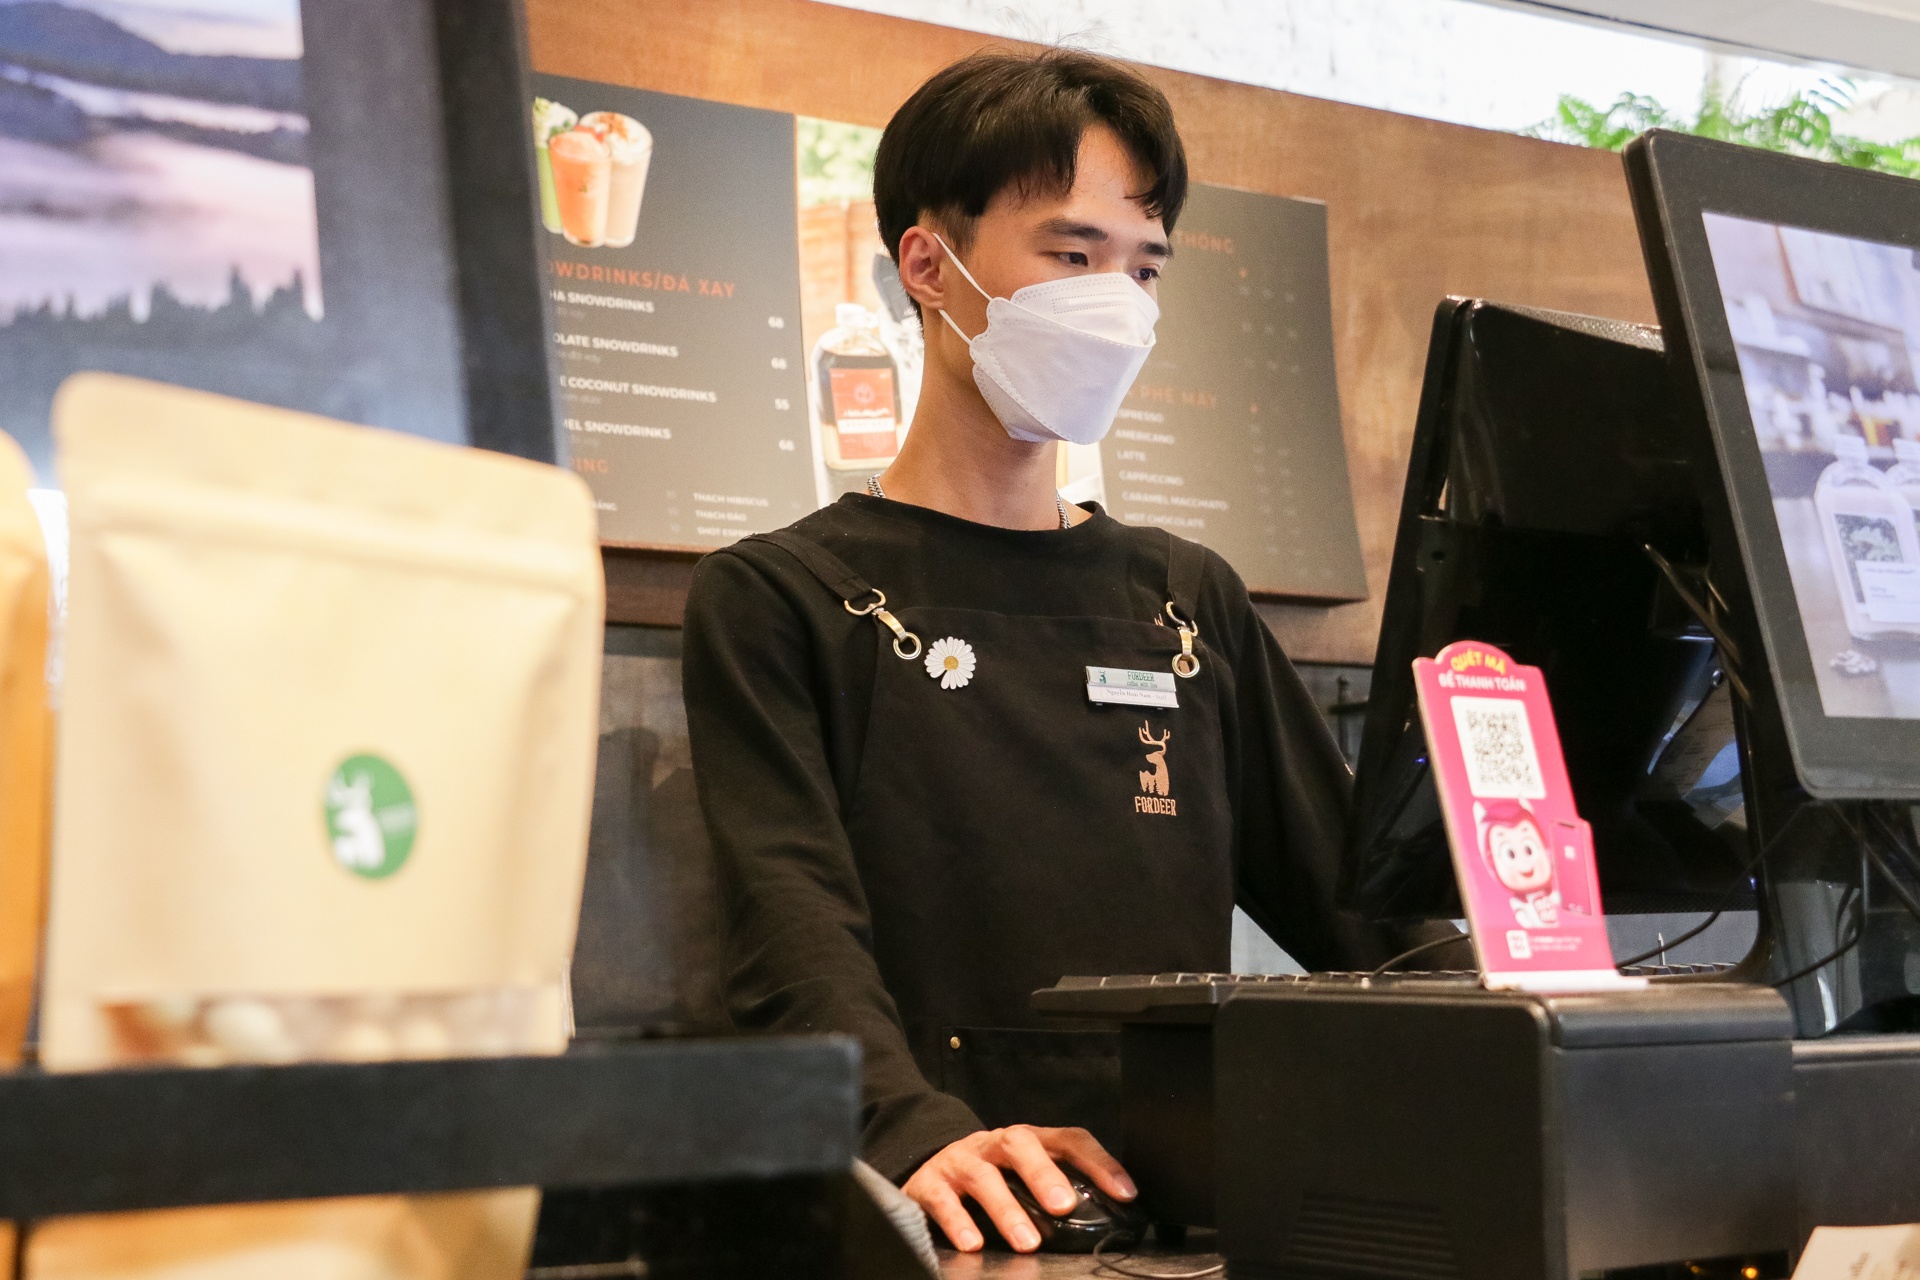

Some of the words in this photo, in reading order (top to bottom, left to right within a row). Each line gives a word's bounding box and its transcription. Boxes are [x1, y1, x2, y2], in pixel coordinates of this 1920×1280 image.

[698, 279, 735, 298] XAY
[567, 291, 655, 314] SNOWDRINKS
[592, 336, 679, 359] SNOWDRINKS
[568, 376, 629, 395] COCONUT
[631, 383, 718, 404] SNOWDRINKS
[584, 420, 673, 441] SNOWDRINKS
[1127, 671, 1155, 682] FORDEER
[1455, 674, 1495, 691] THANH
[1135, 796, 1177, 816] FORDEER
